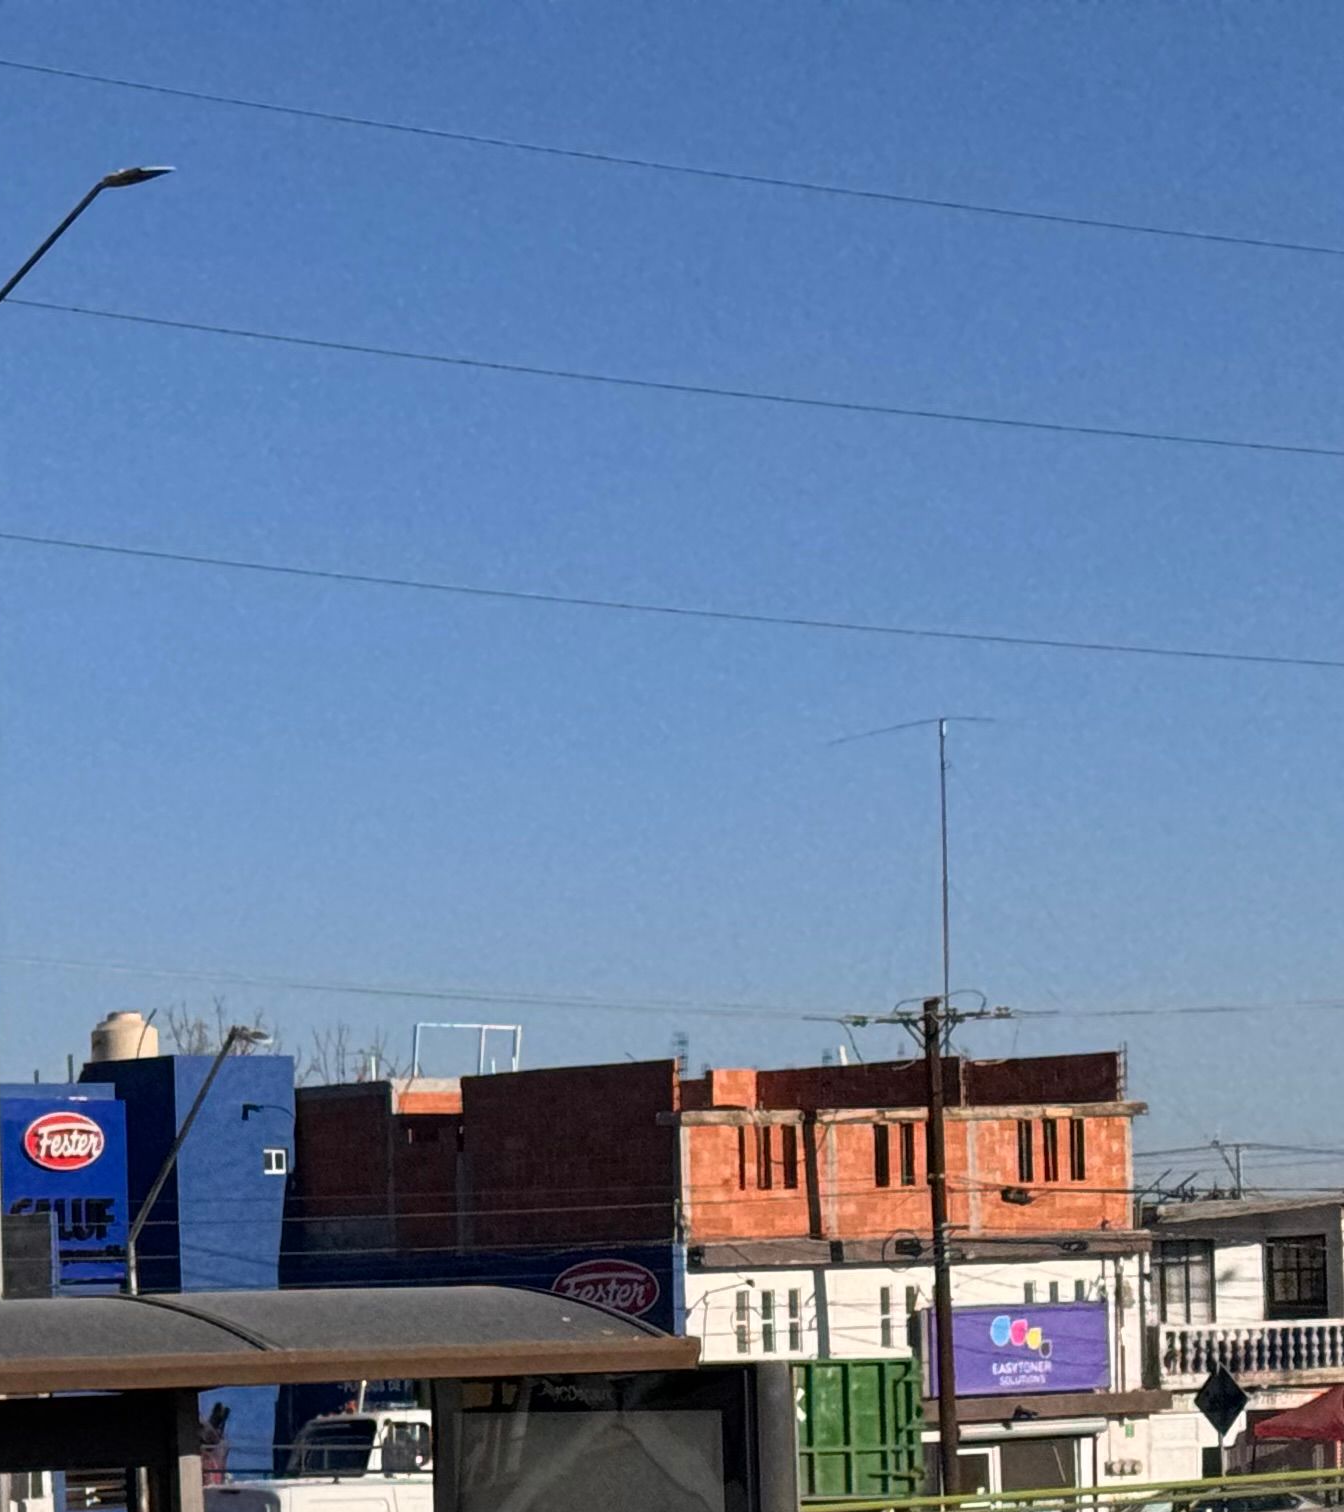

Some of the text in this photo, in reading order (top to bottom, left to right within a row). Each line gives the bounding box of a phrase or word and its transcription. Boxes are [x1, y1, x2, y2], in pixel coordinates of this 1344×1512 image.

[38, 1122, 102, 1158] Fester
[10, 1197, 116, 1242] LUF
[562, 1272, 646, 1308] Fester
